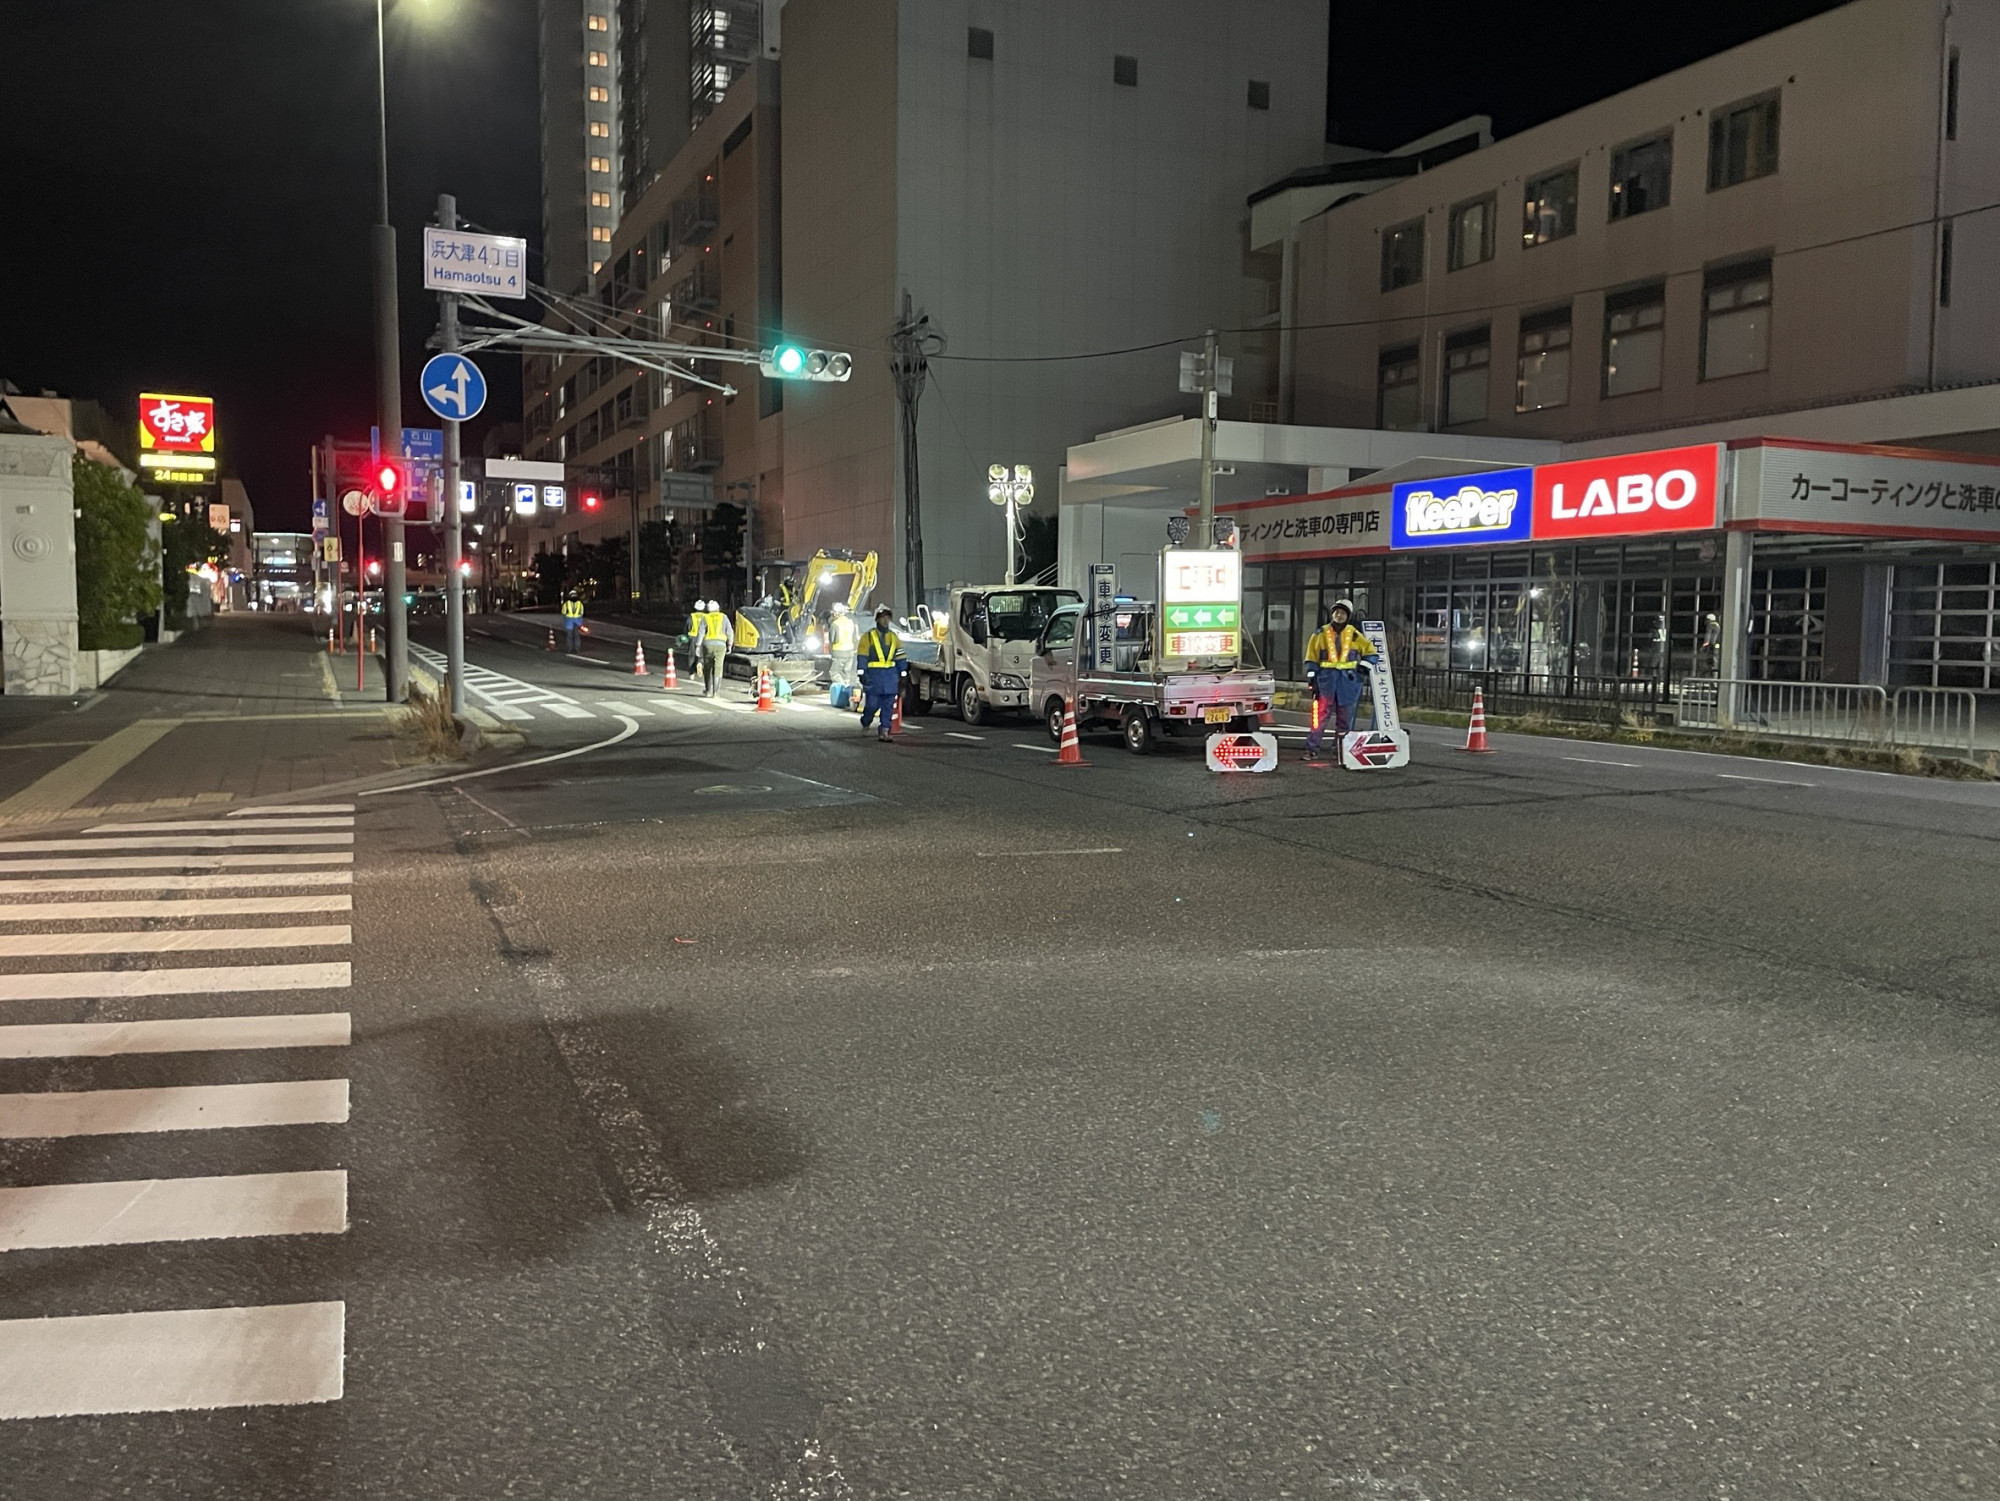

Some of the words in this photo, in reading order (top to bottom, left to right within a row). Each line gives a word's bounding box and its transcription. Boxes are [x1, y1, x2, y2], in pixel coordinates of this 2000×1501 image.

[431, 240, 519, 268] 浜大津4丁目
[433, 267, 501, 286] Hamaotsu
[508, 275, 517, 288] 4
[149, 399, 207, 438] すき家
[1551, 469, 1697, 520] LABO
[1013, 655, 1020, 664] 3
